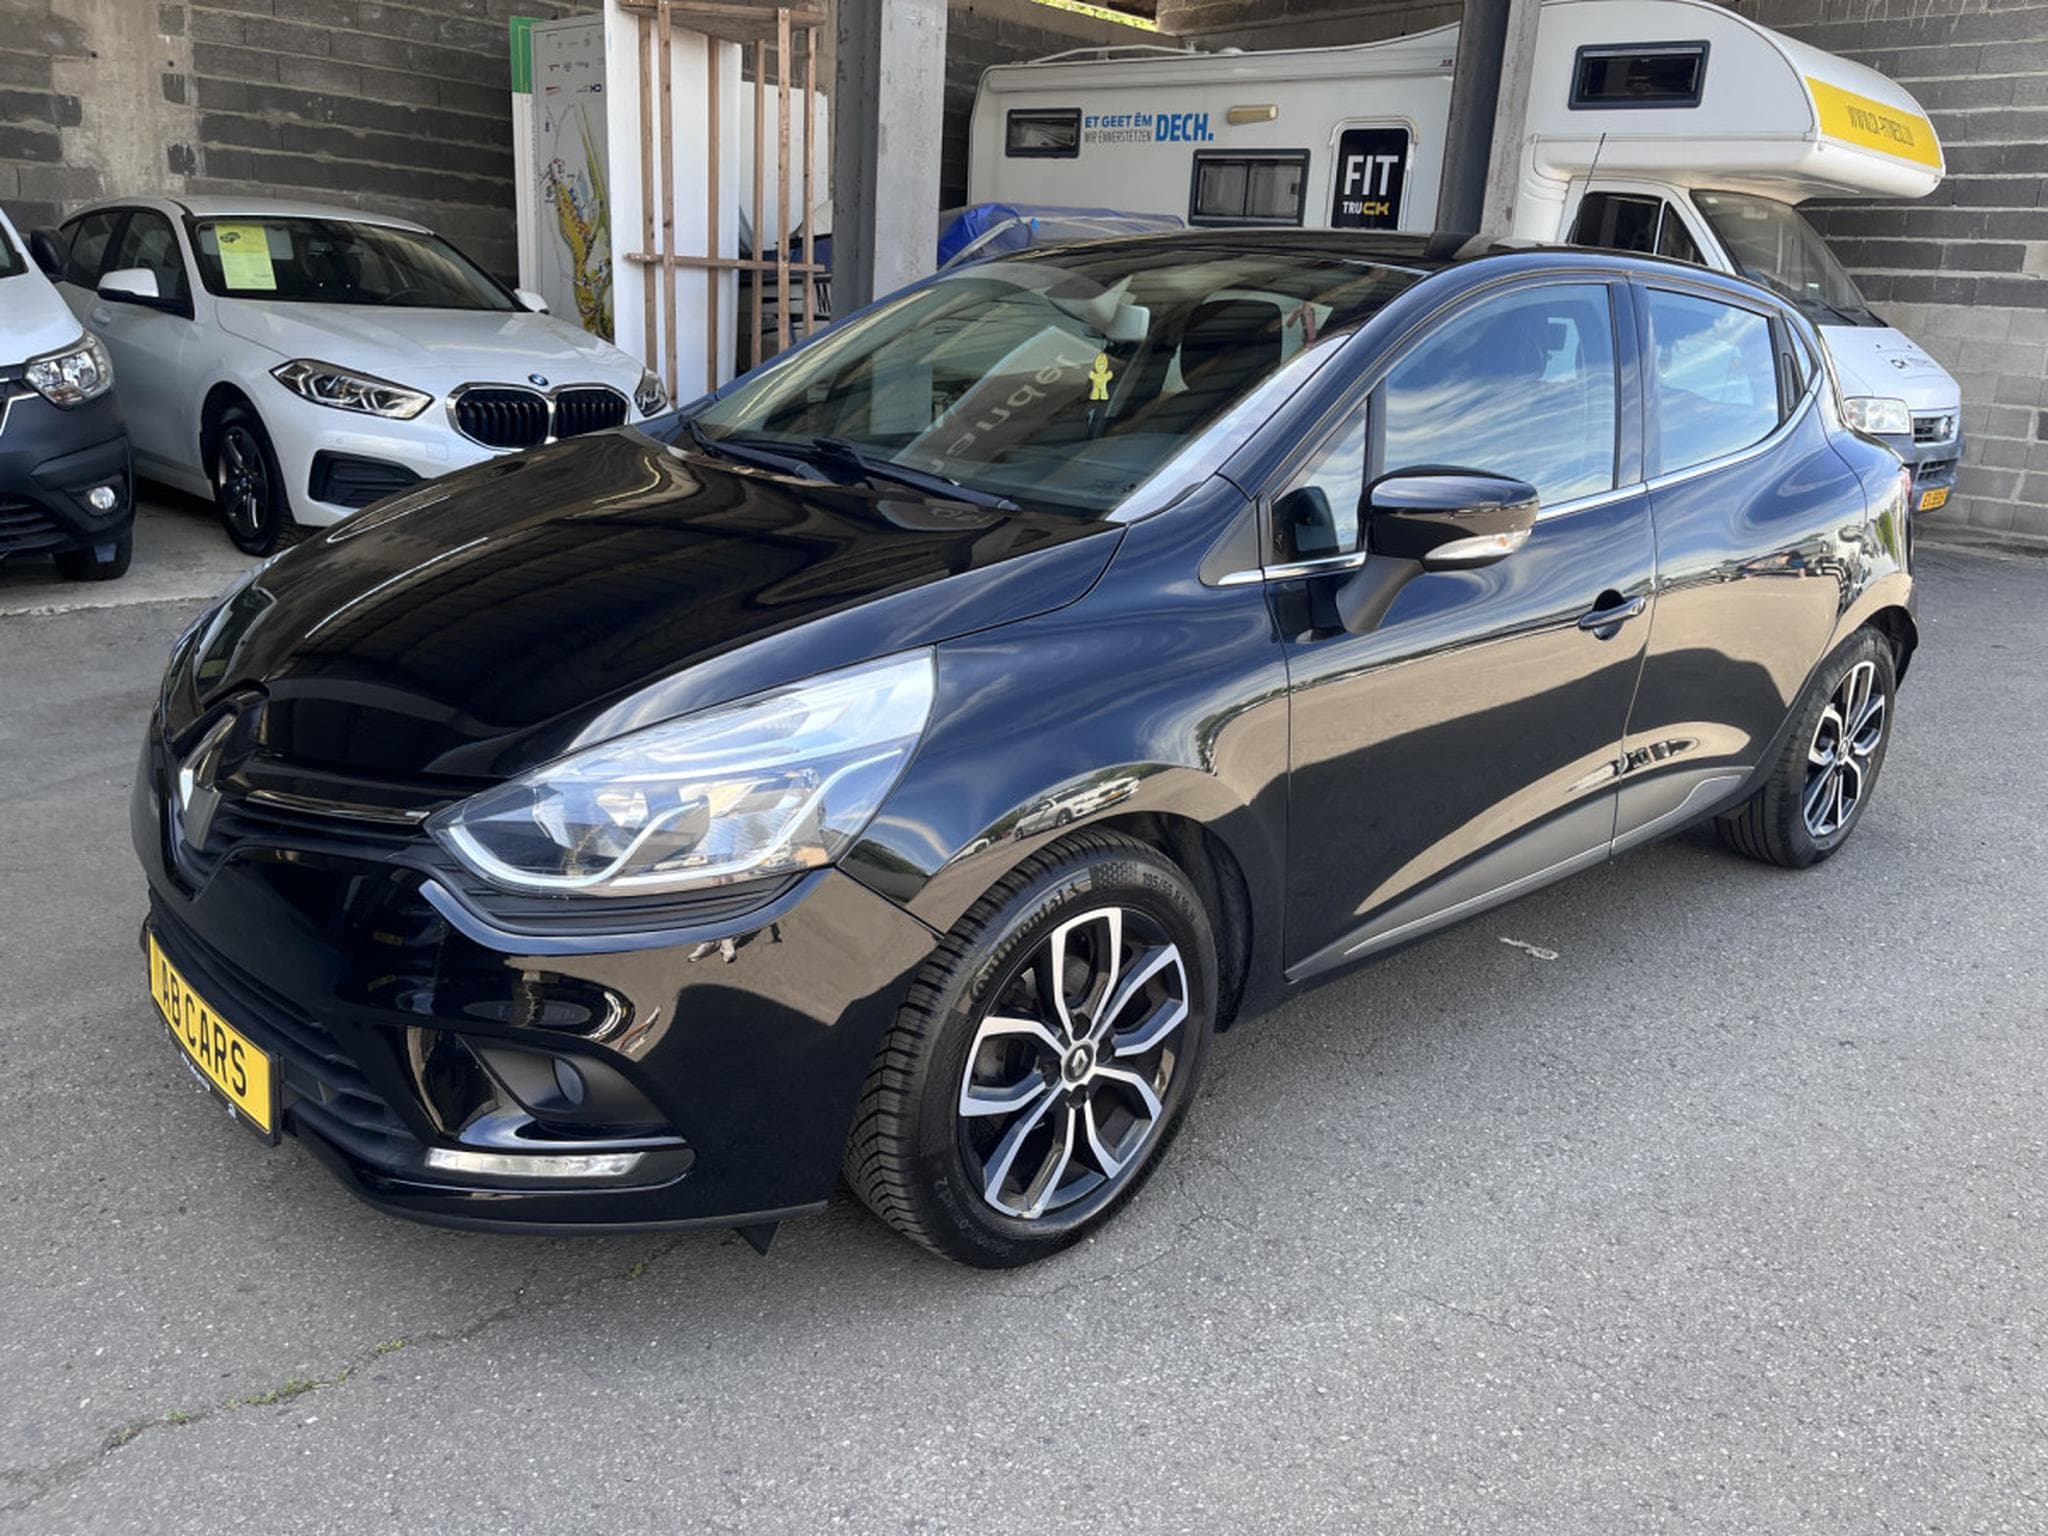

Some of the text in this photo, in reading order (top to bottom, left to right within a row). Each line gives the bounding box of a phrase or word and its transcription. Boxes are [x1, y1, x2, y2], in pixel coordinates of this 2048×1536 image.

[1085, 116, 1100, 128] ET
[1102, 115, 1132, 128] GEET
[1155, 113, 1214, 142] DECH.
[1344, 155, 1399, 195] FIT
[1343, 201, 1390, 215] TRUCK
[970, 888, 1065, 1004] Continental
